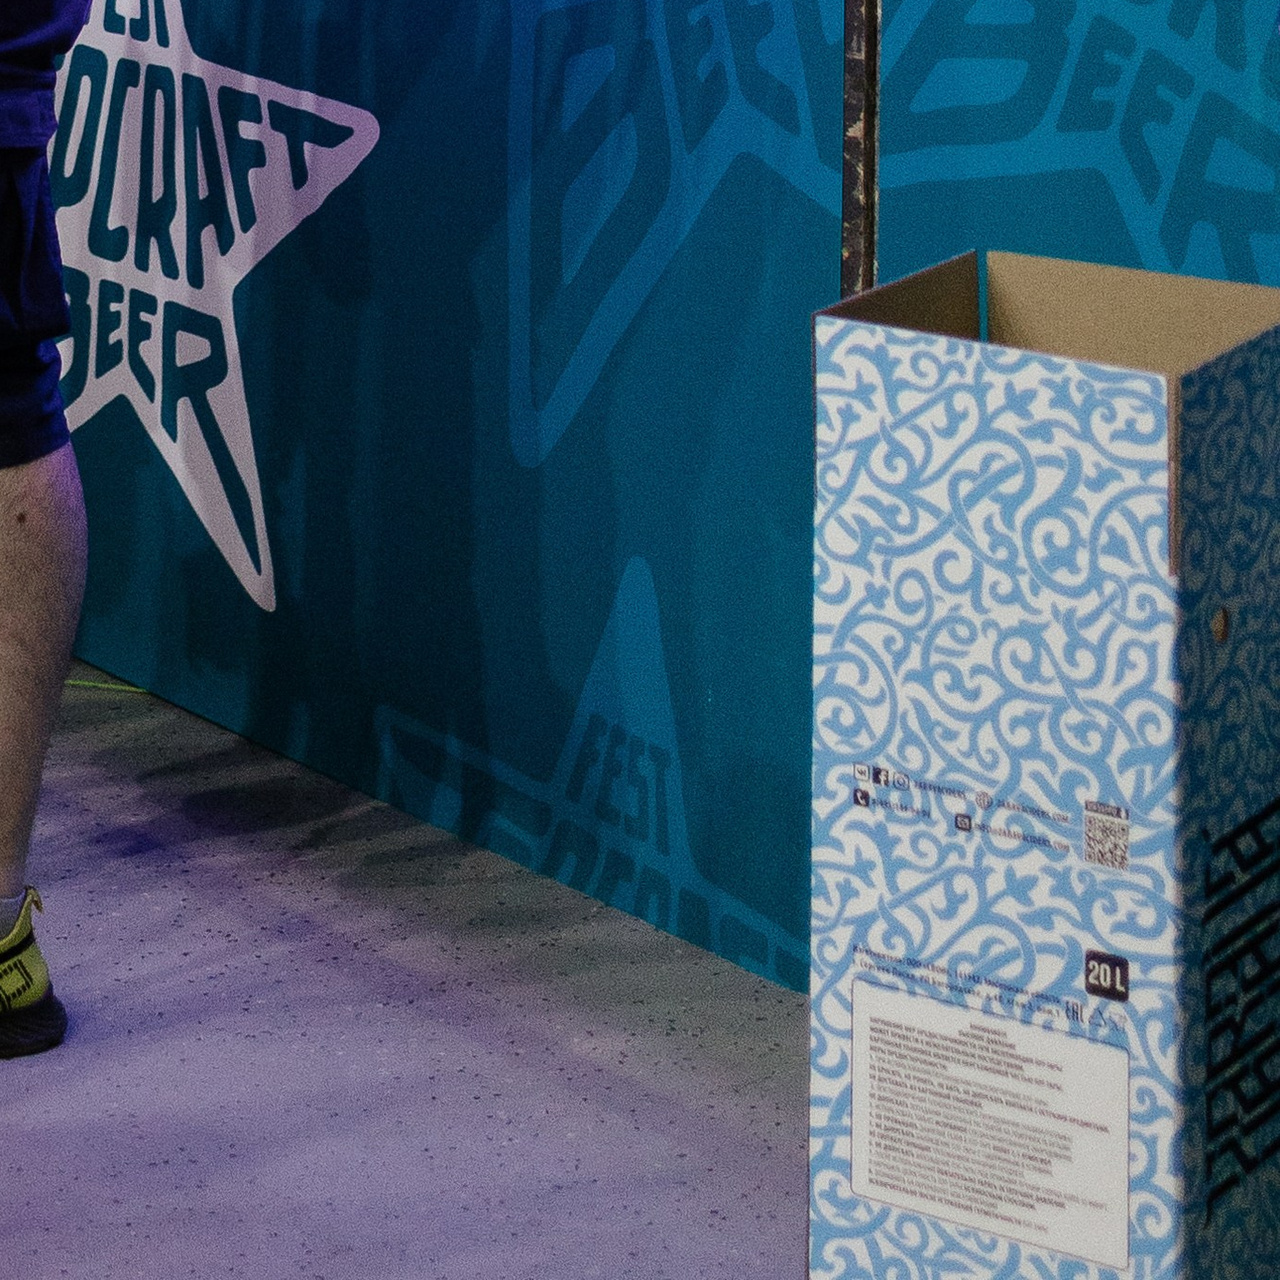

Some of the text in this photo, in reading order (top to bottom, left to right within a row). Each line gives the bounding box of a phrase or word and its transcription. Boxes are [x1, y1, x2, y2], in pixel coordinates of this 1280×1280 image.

[50, 44, 355, 290] PCRAFT
[1087, 960, 1110, 989] 20
[1114, 968, 1126, 992] L
